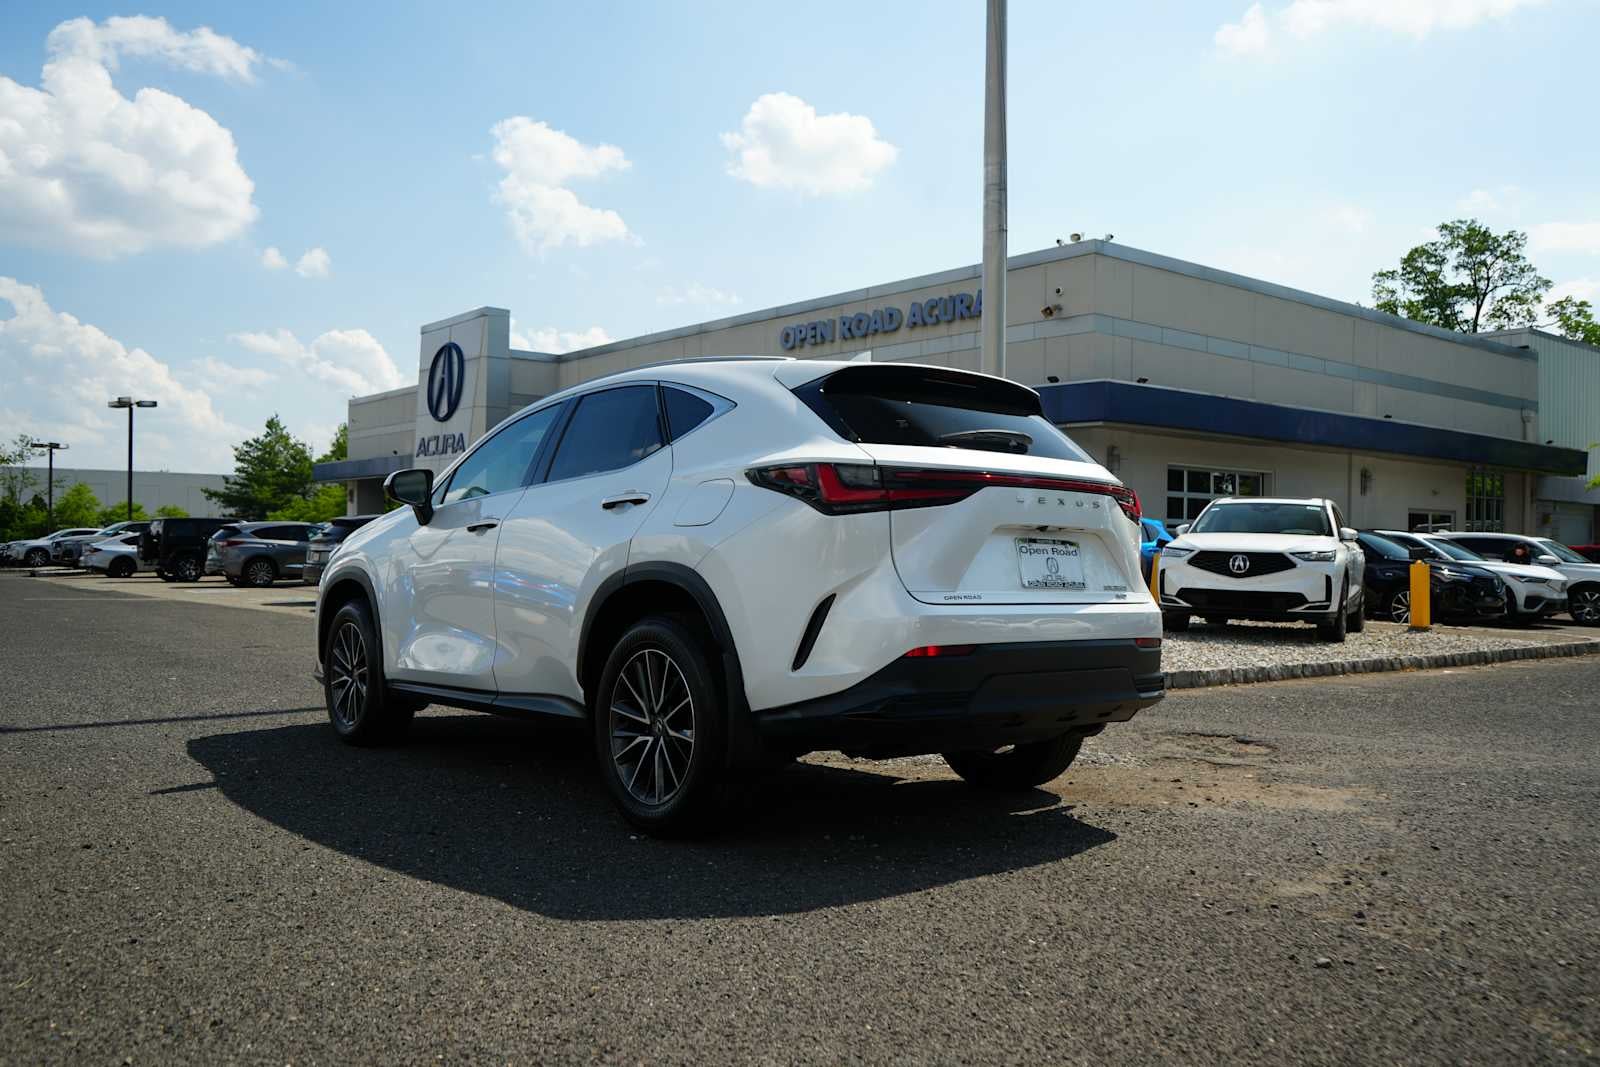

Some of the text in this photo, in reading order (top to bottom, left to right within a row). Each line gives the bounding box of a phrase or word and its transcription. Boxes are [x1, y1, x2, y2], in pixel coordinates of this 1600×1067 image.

[781, 318, 834, 350] OPEN
[839, 307, 902, 339] ROAD
[416, 432, 466, 458] ACURA
[1016, 496, 1100, 509] LEXUS
[1020, 545, 1078, 557] Open Road
